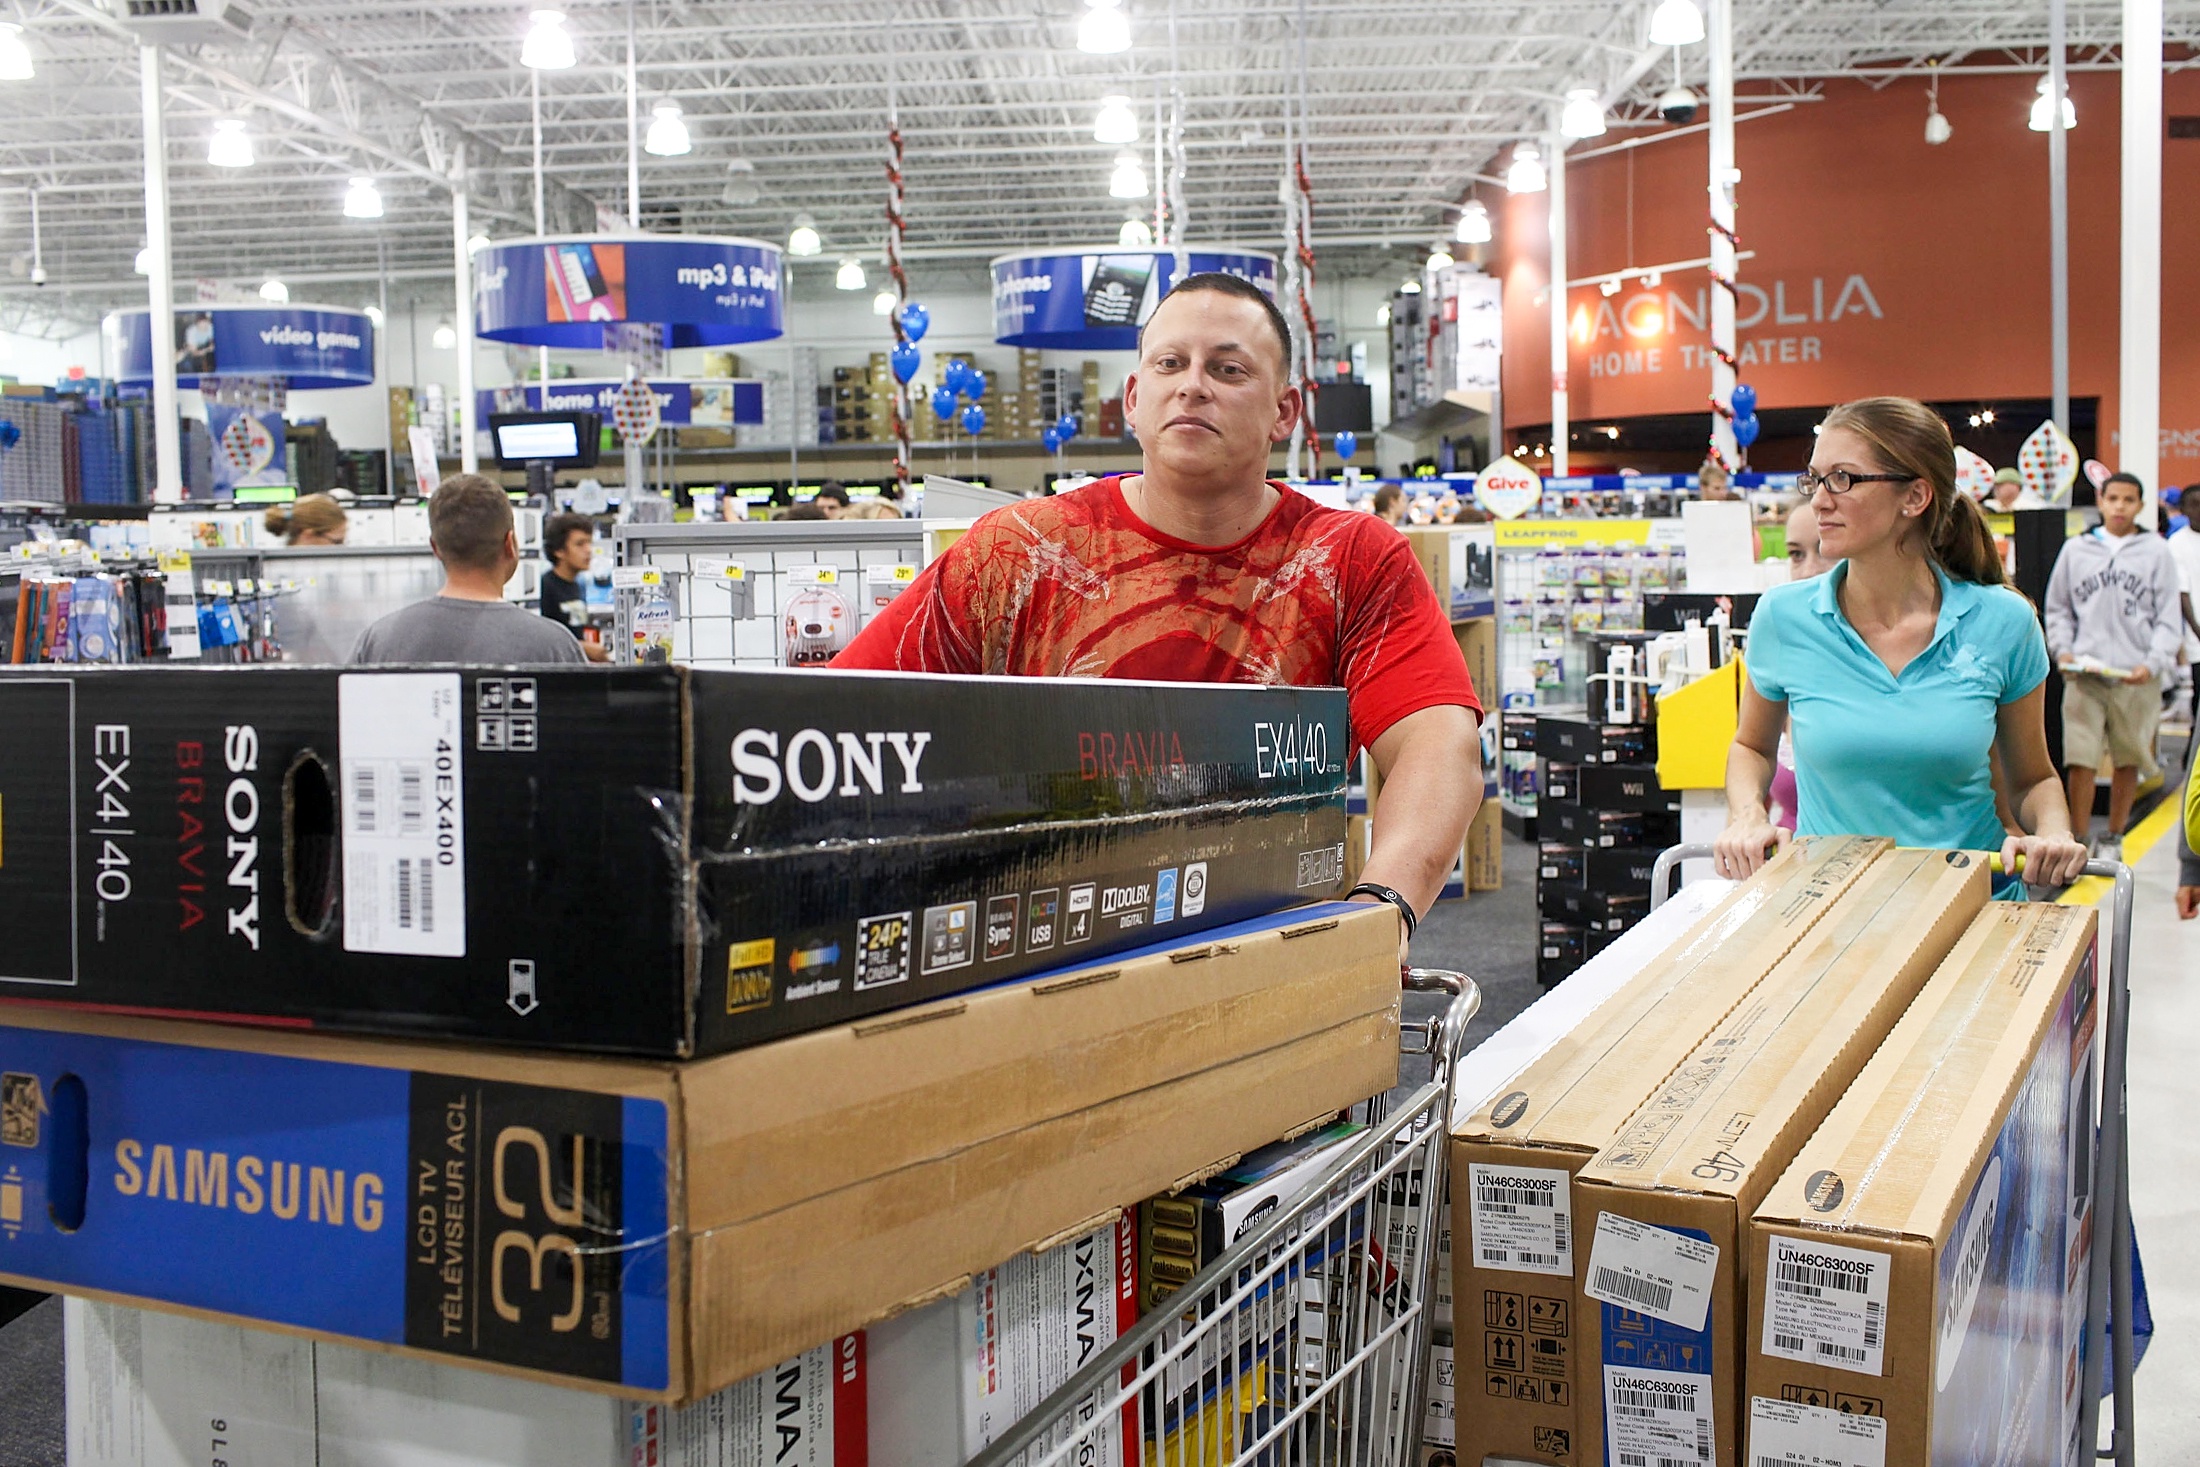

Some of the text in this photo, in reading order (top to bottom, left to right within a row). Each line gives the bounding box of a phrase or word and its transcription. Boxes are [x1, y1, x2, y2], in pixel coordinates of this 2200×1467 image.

[677, 263, 727, 289] mp3
[733, 267, 747, 286] &
[260, 325, 360, 349] video games
[1589, 336, 1822, 377] HOME THATER
[1487, 476, 1530, 491] Give
[1503, 529, 1578, 540] LEAPFROG
[637, 609, 669, 620] Refresh
[730, 728, 932, 805] SONY
[1078, 730, 1187, 782] BRAVIA
[1622, 781, 1645, 796] Wii
[434, 739, 455, 867] 40EX400
[176, 741, 206, 931] BRAVIA
[224, 725, 260, 950] SONY
[1117, 883, 1150, 908] DOLBY
[1031, 923, 1052, 944] USB
[1119, 915, 1143, 929] DIGITAL
[868, 921, 902, 950] 24P
[988, 924, 1012, 947] Sync
[446, 1092, 468, 1152] ACL
[1692, 1151, 1747, 1182] 46
[114, 1138, 385, 1232] SAMSUNG
[1477, 1175, 1557, 1191] UN46C6300SF
[417, 1160, 438, 1266] LCD TV
[491, 1125, 586, 1333] 32
[1778, 1249, 1875, 1275] UN46C6300SF
[1946, 1198, 1994, 1341] SAMSUNG
[1075, 1234, 1095, 1369] IXMA
[1549, 1303, 1561, 1318] 7
[1505, 1310, 1517, 1327] 6
[1774, 1314, 1800, 1324] SAMSUNG
[1800, 1318, 1837, 1330] ELECTRONICS
[1774, 1320, 1789, 1328] MADE
[1798, 1325, 1817, 1333] MEXICO
[1773, 1327, 1799, 1336] FABRIQUE
[1809, 1333, 1834, 1342] MEXIQUE
[816, 1359, 824, 1430] All-In-One
[1613, 1377, 1699, 1395] UN46C6300SF
[807, 1370, 816, 1462] Fotográfica de
